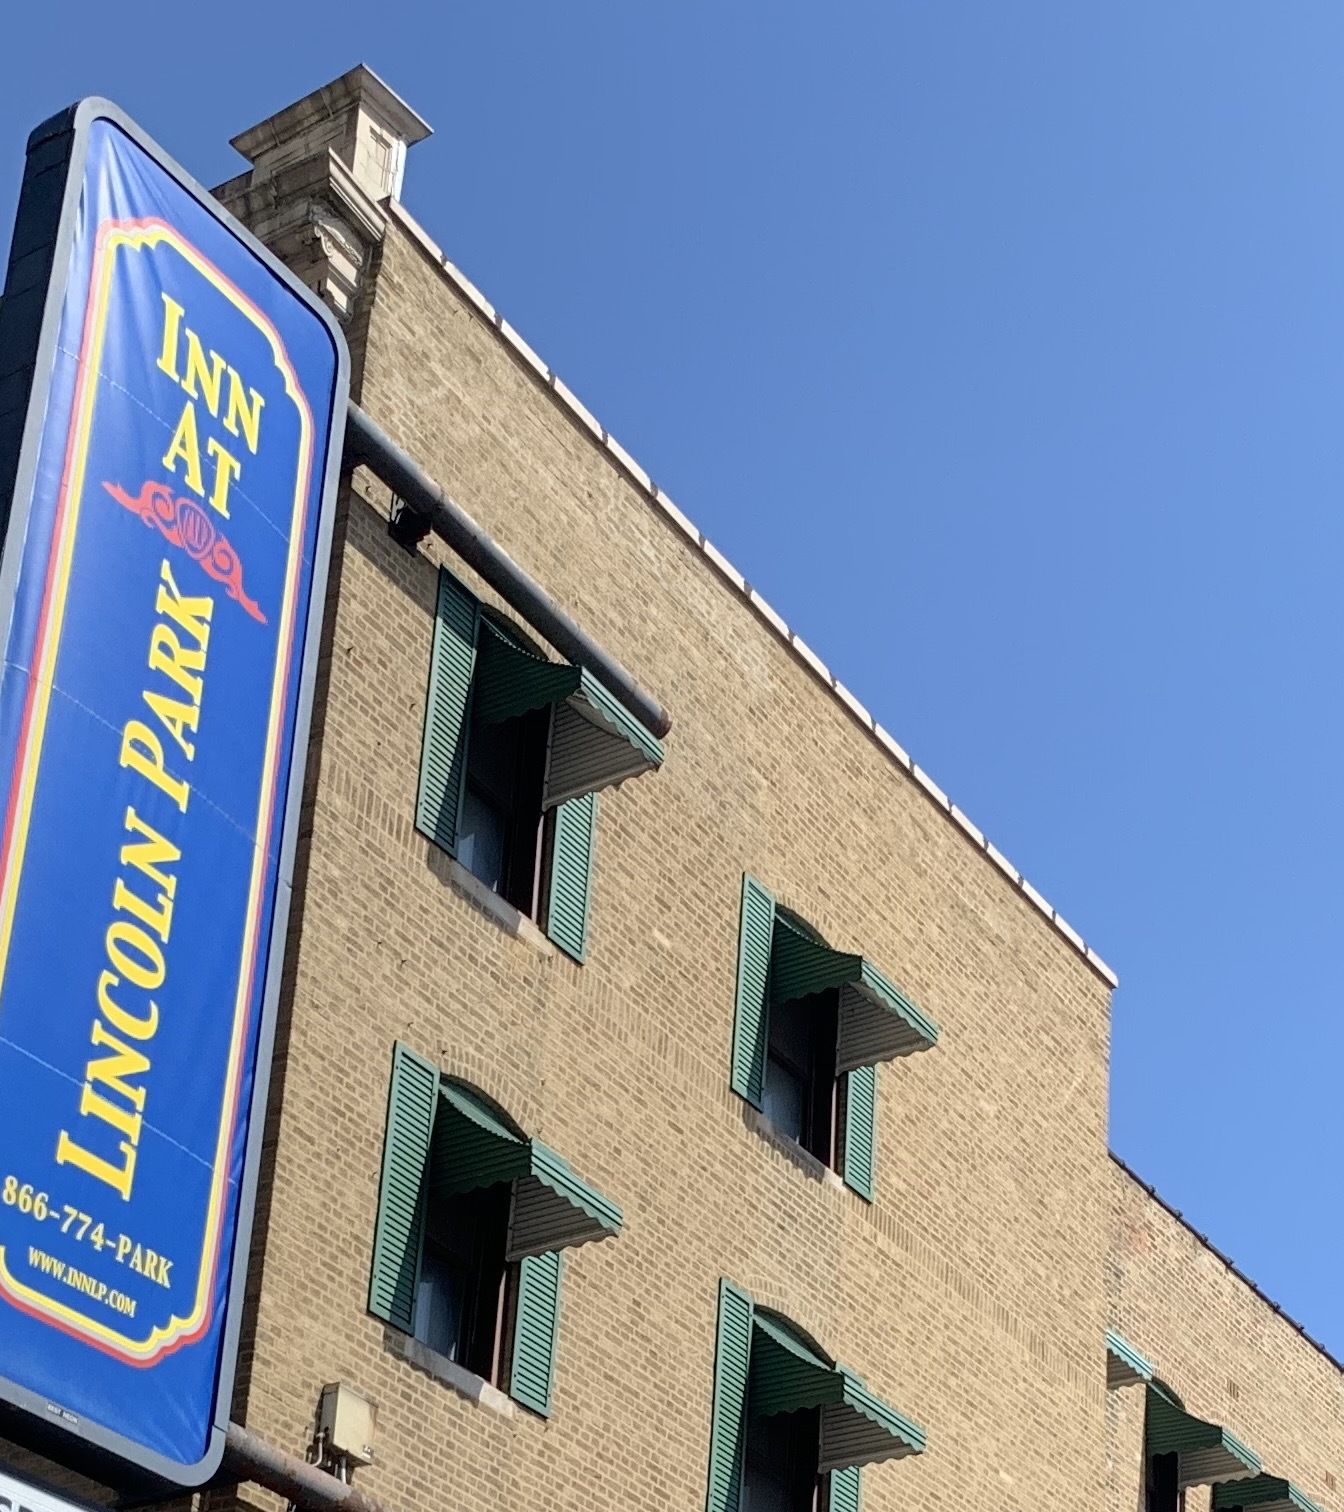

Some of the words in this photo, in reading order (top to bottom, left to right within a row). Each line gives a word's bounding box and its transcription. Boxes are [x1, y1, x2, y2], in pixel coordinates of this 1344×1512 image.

[156, 292, 265, 455] INN
[162, 401, 240, 519] AT
[56, 807, 181, 1200] LINCOLN
[120, 559, 214, 813] PARK
[2, 1175, 174, 1289] 866-774-PARK
